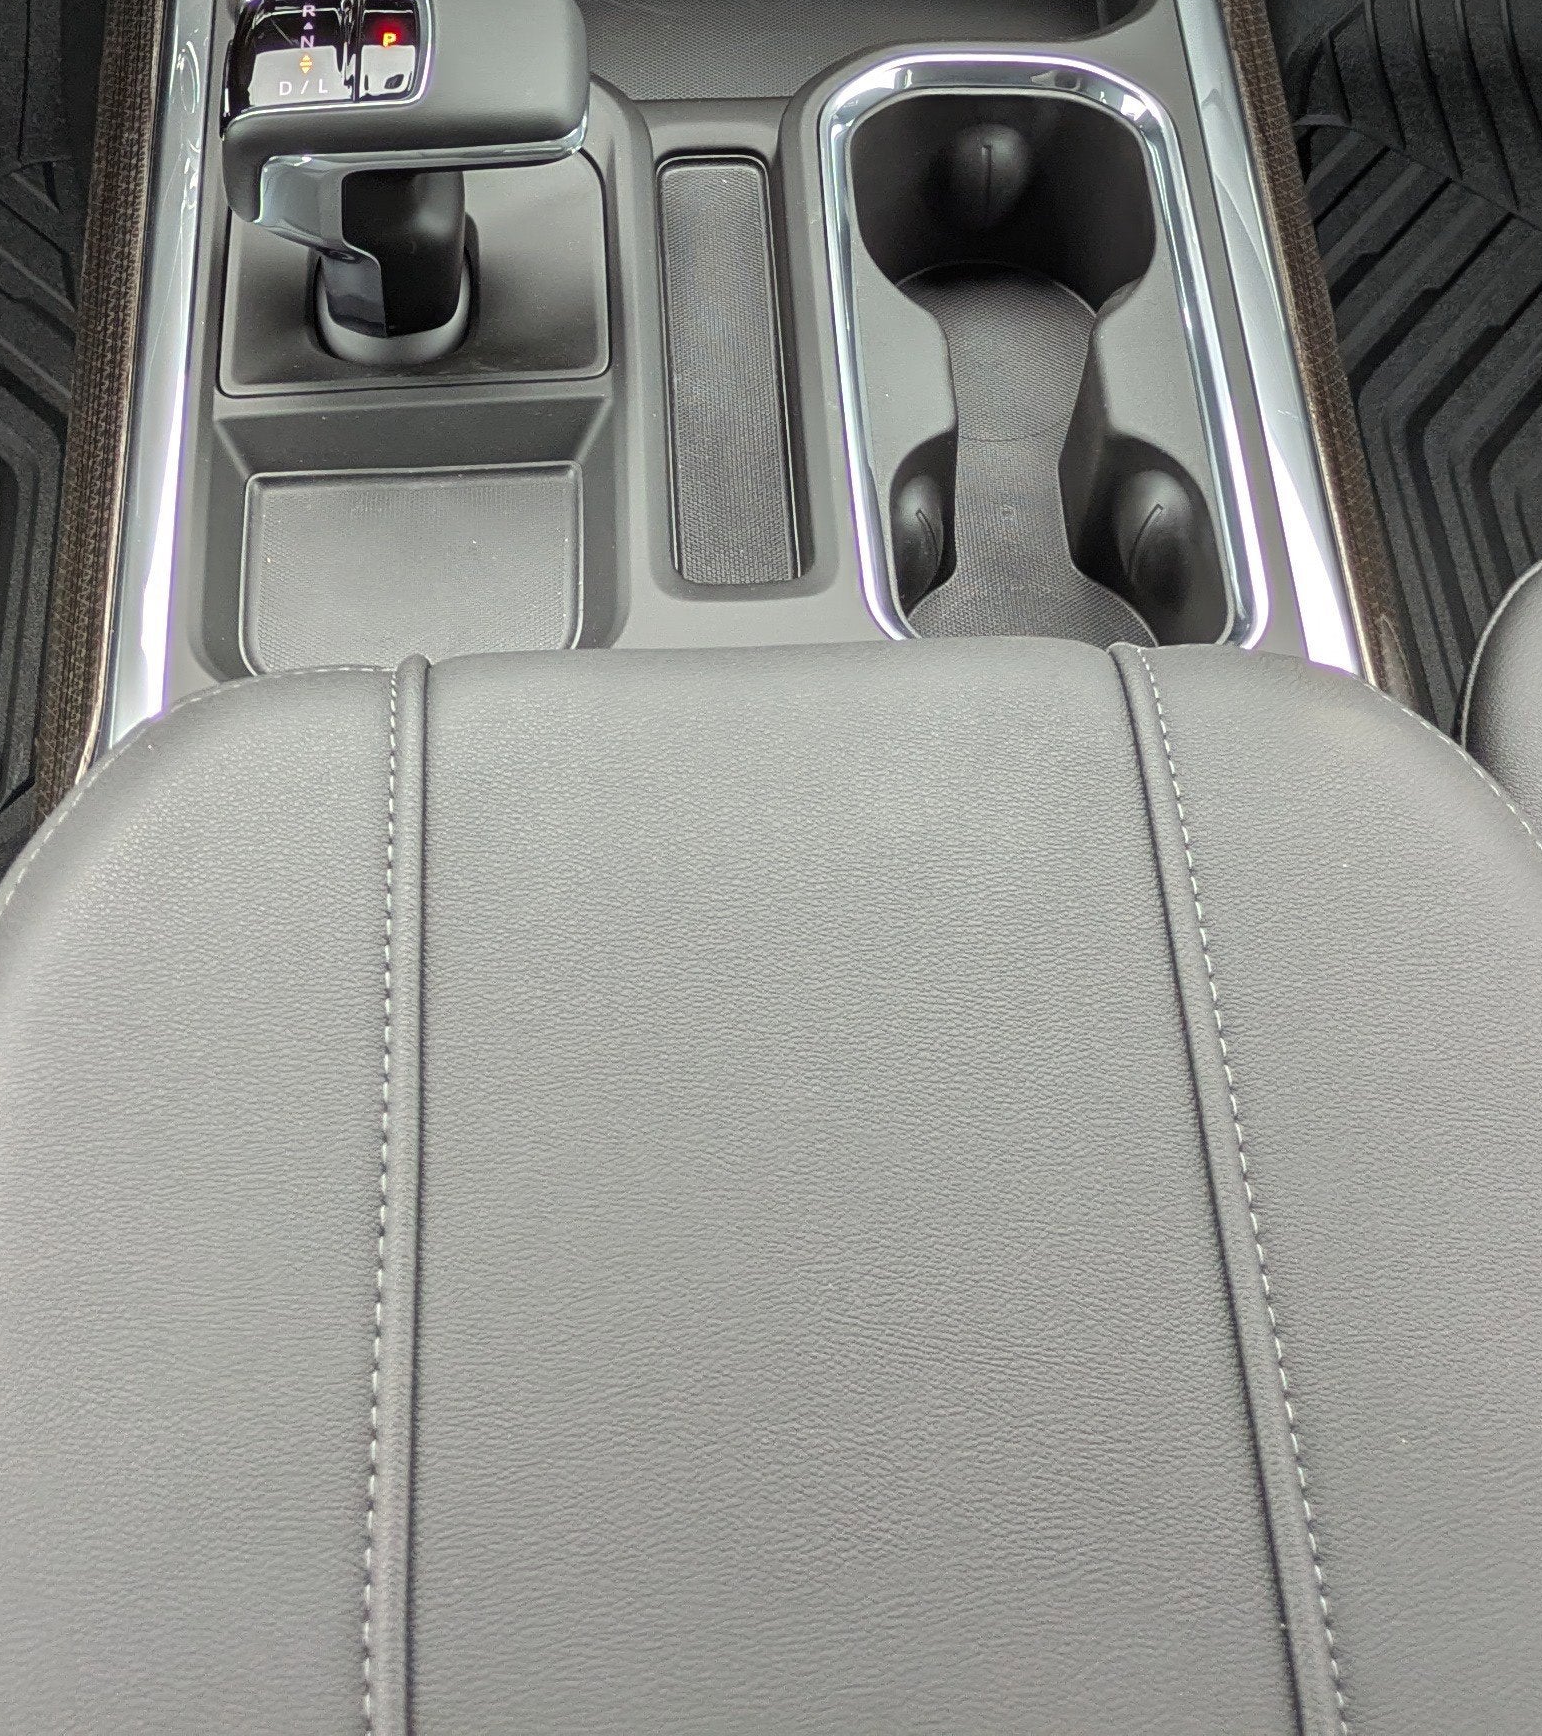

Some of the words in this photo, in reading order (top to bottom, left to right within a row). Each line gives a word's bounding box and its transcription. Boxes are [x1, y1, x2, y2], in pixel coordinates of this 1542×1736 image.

[301, 4, 317, 18] R
[299, 34, 315, 49] N
[382, 32, 397, 48] P
[279, 80, 294, 96] D
[318, 78, 329, 94] L
